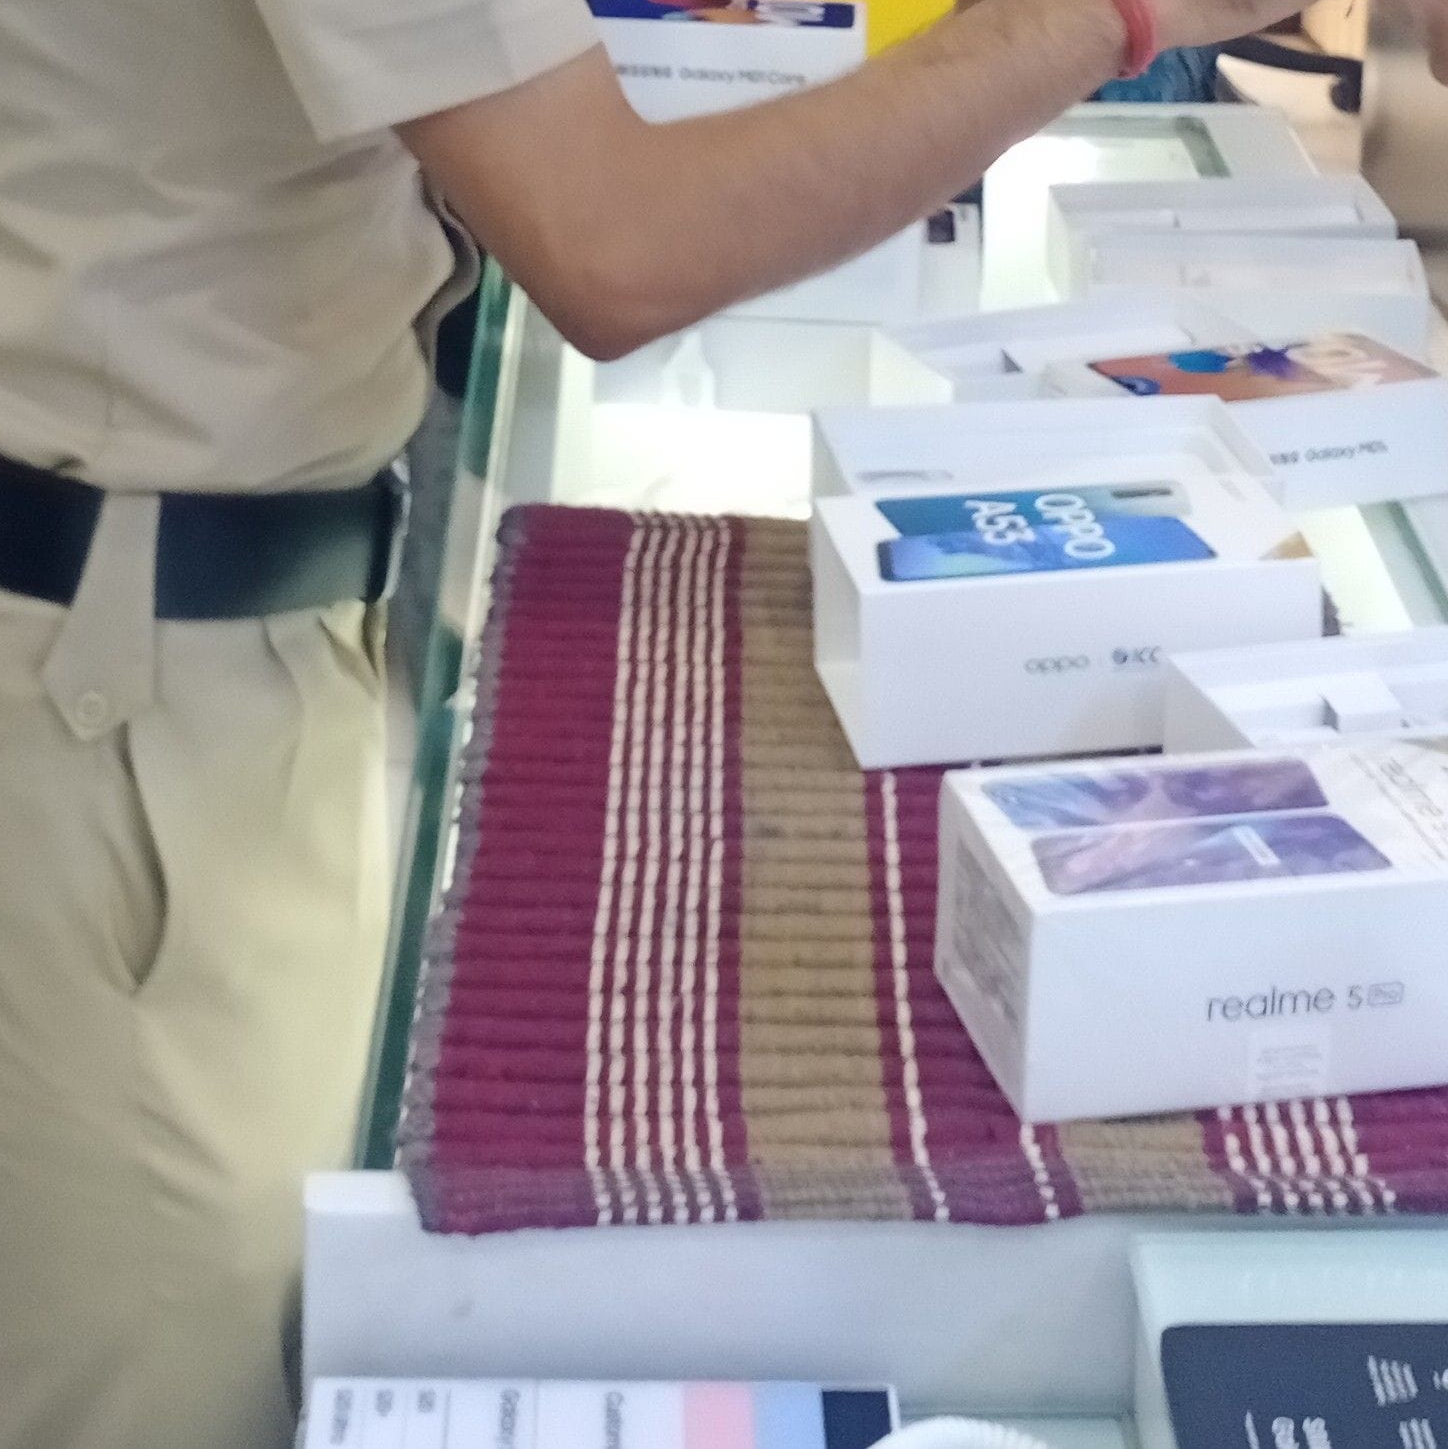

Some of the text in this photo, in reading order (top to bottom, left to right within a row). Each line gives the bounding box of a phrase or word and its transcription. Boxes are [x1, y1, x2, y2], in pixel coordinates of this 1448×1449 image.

[1033, 493, 1117, 560] OPPO
[1206, 985, 1337, 1022] realme
[1346, 984, 1364, 1011] 5
